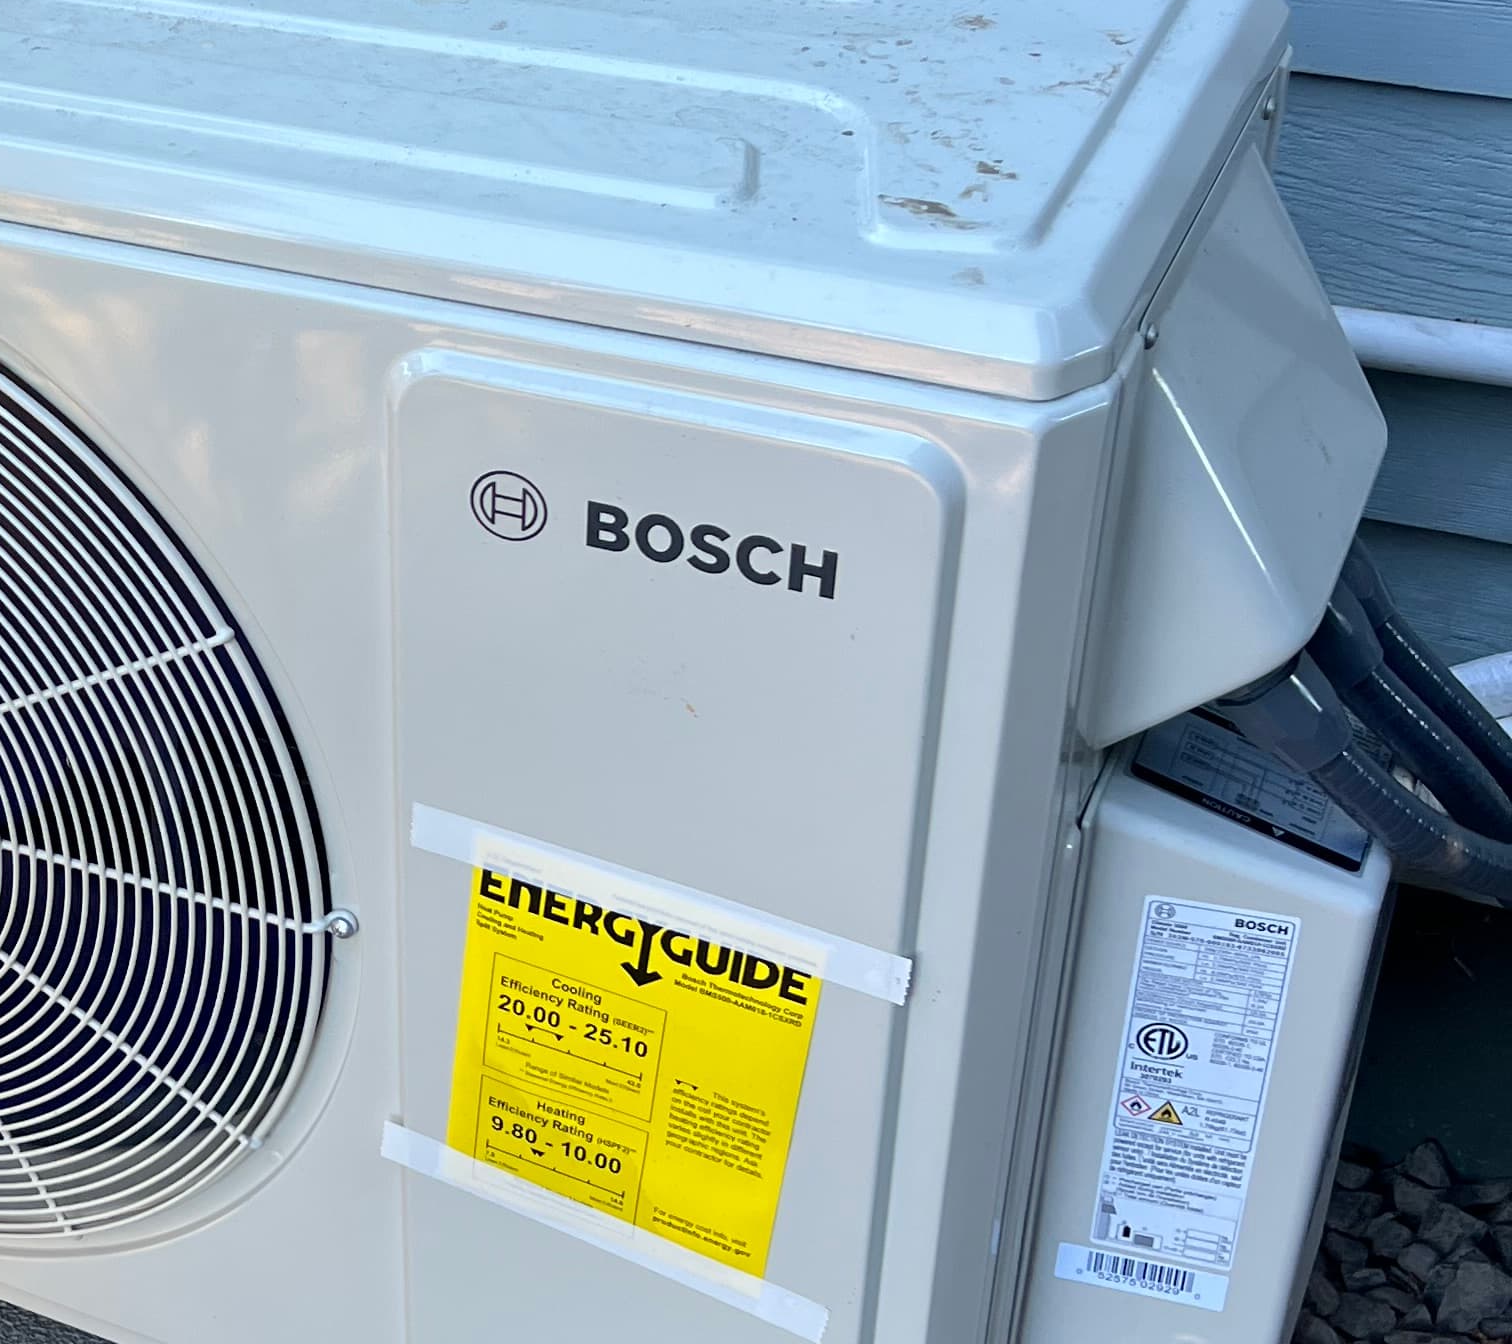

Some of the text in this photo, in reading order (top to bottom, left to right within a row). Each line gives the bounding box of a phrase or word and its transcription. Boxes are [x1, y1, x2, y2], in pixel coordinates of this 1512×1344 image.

[586, 500, 838, 599] BOSCH
[1201, 797, 1251, 824] CAUTION
[1234, 918, 1288, 934] BOSCH
[501, 976, 563, 1006] Efficiency
[567, 999, 609, 1023] Rating
[551, 978, 601, 1004] Cooling
[498, 994, 560, 1028] 20.00
[584, 1023, 648, 1058] 25.10
[1142, 1027, 1182, 1056] ETL
[1130, 1061, 1182, 1078] Intertek
[488, 1097, 548, 1126] Efficiency
[552, 1120, 592, 1143] Rating
[537, 1100, 585, 1126] Heating
[1181, 1105, 1200, 1117] A2L
[491, 1115, 536, 1144] 9.80
[560, 1139, 621, 1175] 10.00
